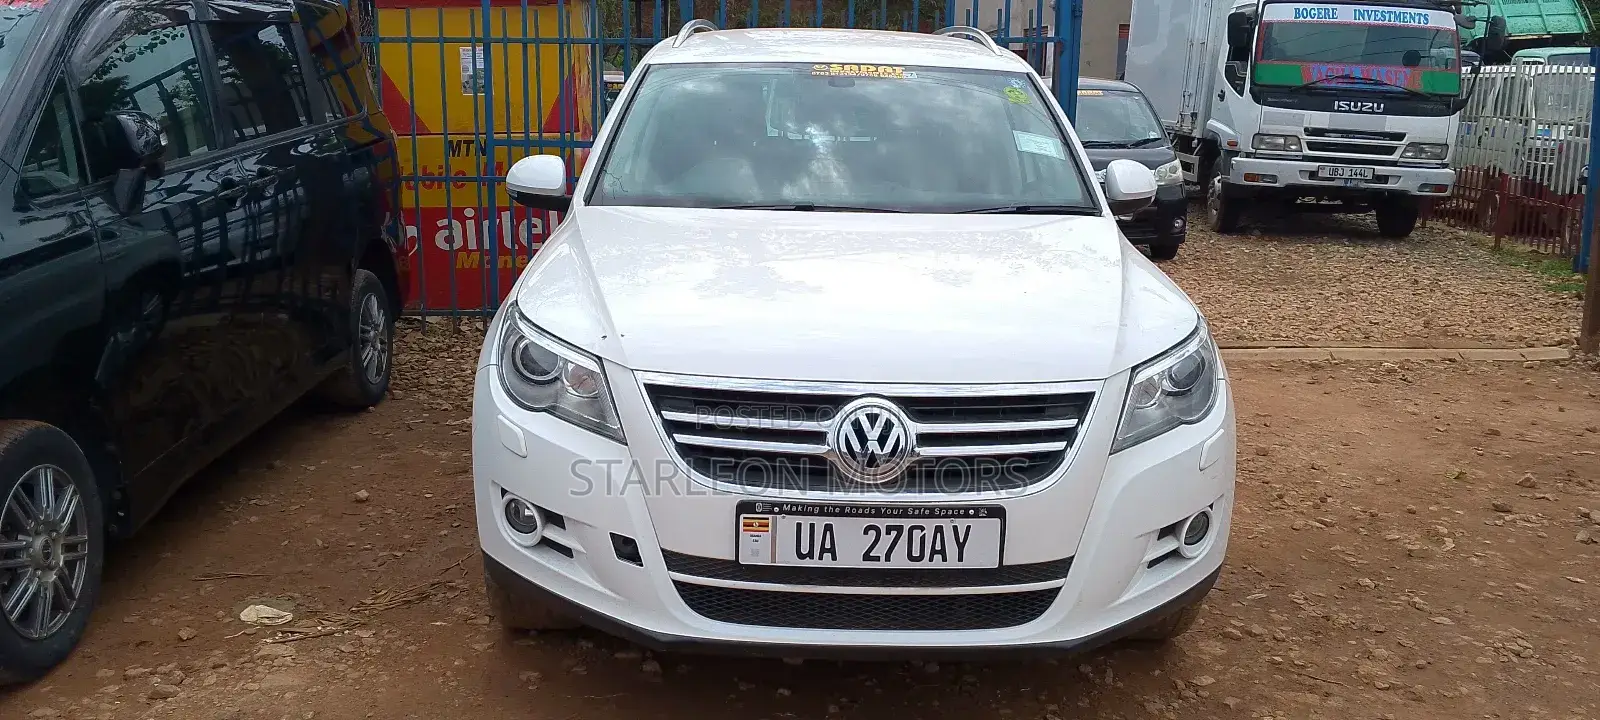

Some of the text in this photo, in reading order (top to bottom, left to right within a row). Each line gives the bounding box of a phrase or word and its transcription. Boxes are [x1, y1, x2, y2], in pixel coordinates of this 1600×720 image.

[1294, 7, 1429, 25] BOGERE INVESTMENTS
[1334, 100, 1385, 112] ISUZU
[448, 139, 487, 157] MTN
[1328, 167, 1368, 178] UBJ 144L
[783, 504, 965, 517] Making the Roads Your Safe Space
[795, 522, 972, 563] UA 270AY
